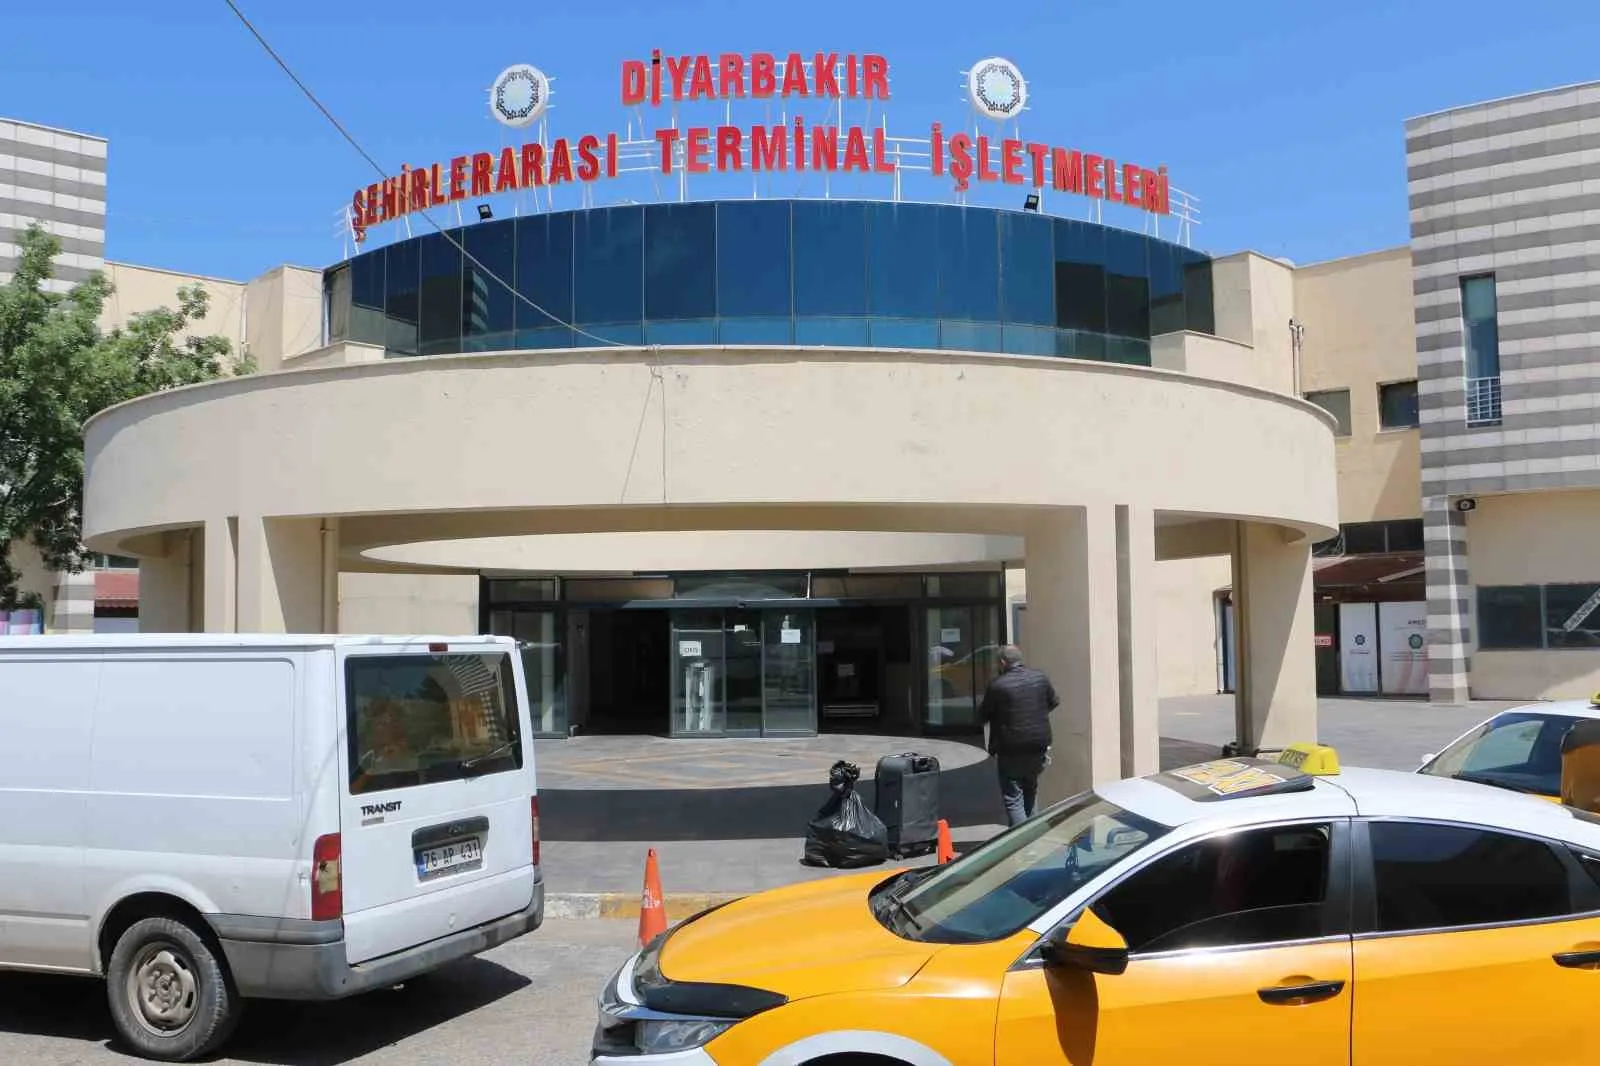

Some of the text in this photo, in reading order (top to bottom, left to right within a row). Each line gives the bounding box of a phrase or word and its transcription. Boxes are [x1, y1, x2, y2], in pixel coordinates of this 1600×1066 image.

[621, 48, 890, 107] DİYARBAKIR
[352, 116, 1170, 242] ŞEHİRLERARASI TERMİNAL İŞLETMELERİ
[360, 801, 402, 816] TRANSIT
[423, 851, 438, 869] 76
